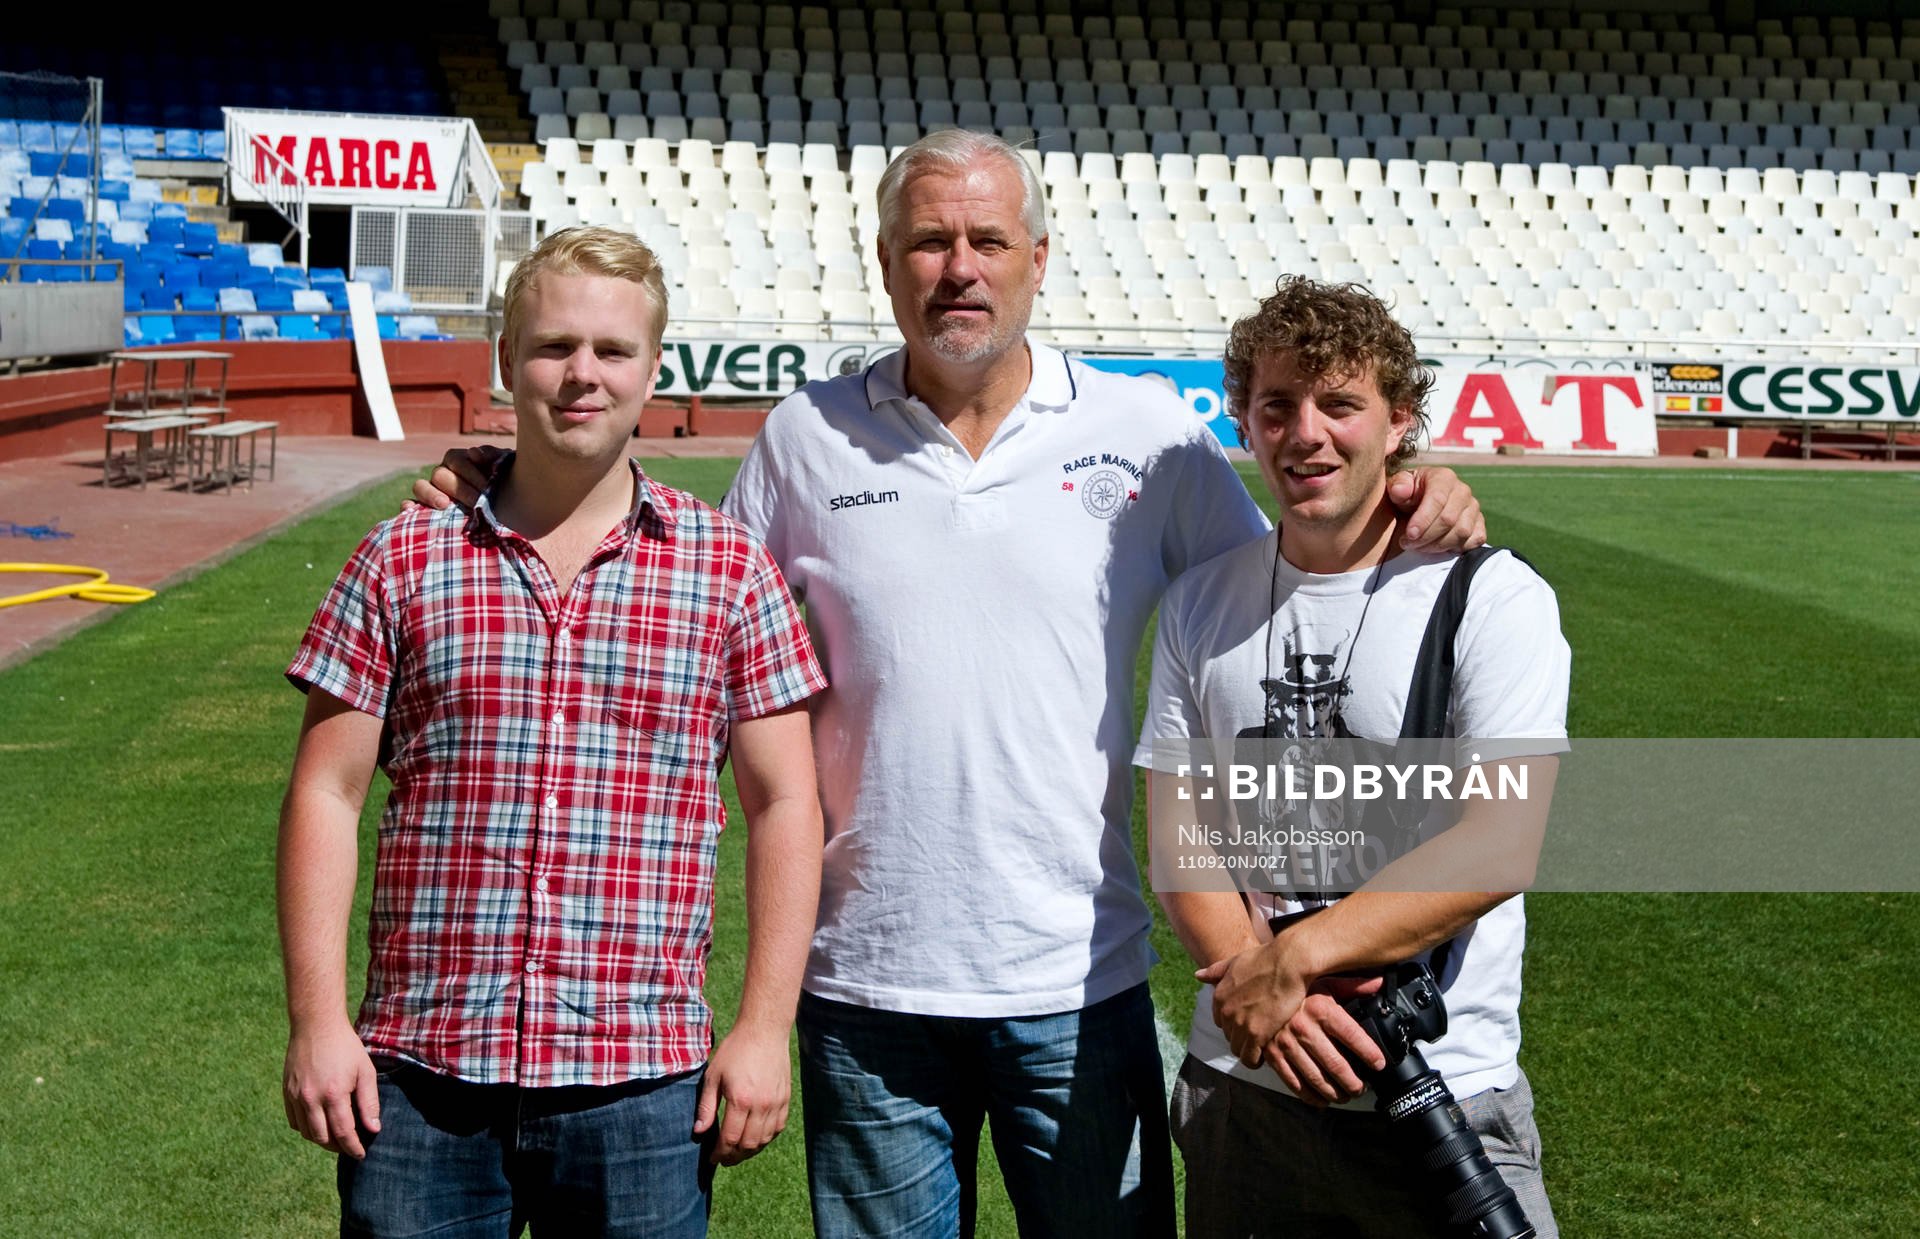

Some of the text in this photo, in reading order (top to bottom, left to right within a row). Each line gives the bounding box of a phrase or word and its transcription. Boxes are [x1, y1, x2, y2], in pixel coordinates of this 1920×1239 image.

[250, 134, 437, 191] MARCA
[1653, 375, 1722, 392] ndersons
[1063, 453, 1143, 481] RACE MARINE
[1062, 482, 1074, 492] 58
[830, 490, 899, 511] stadium
